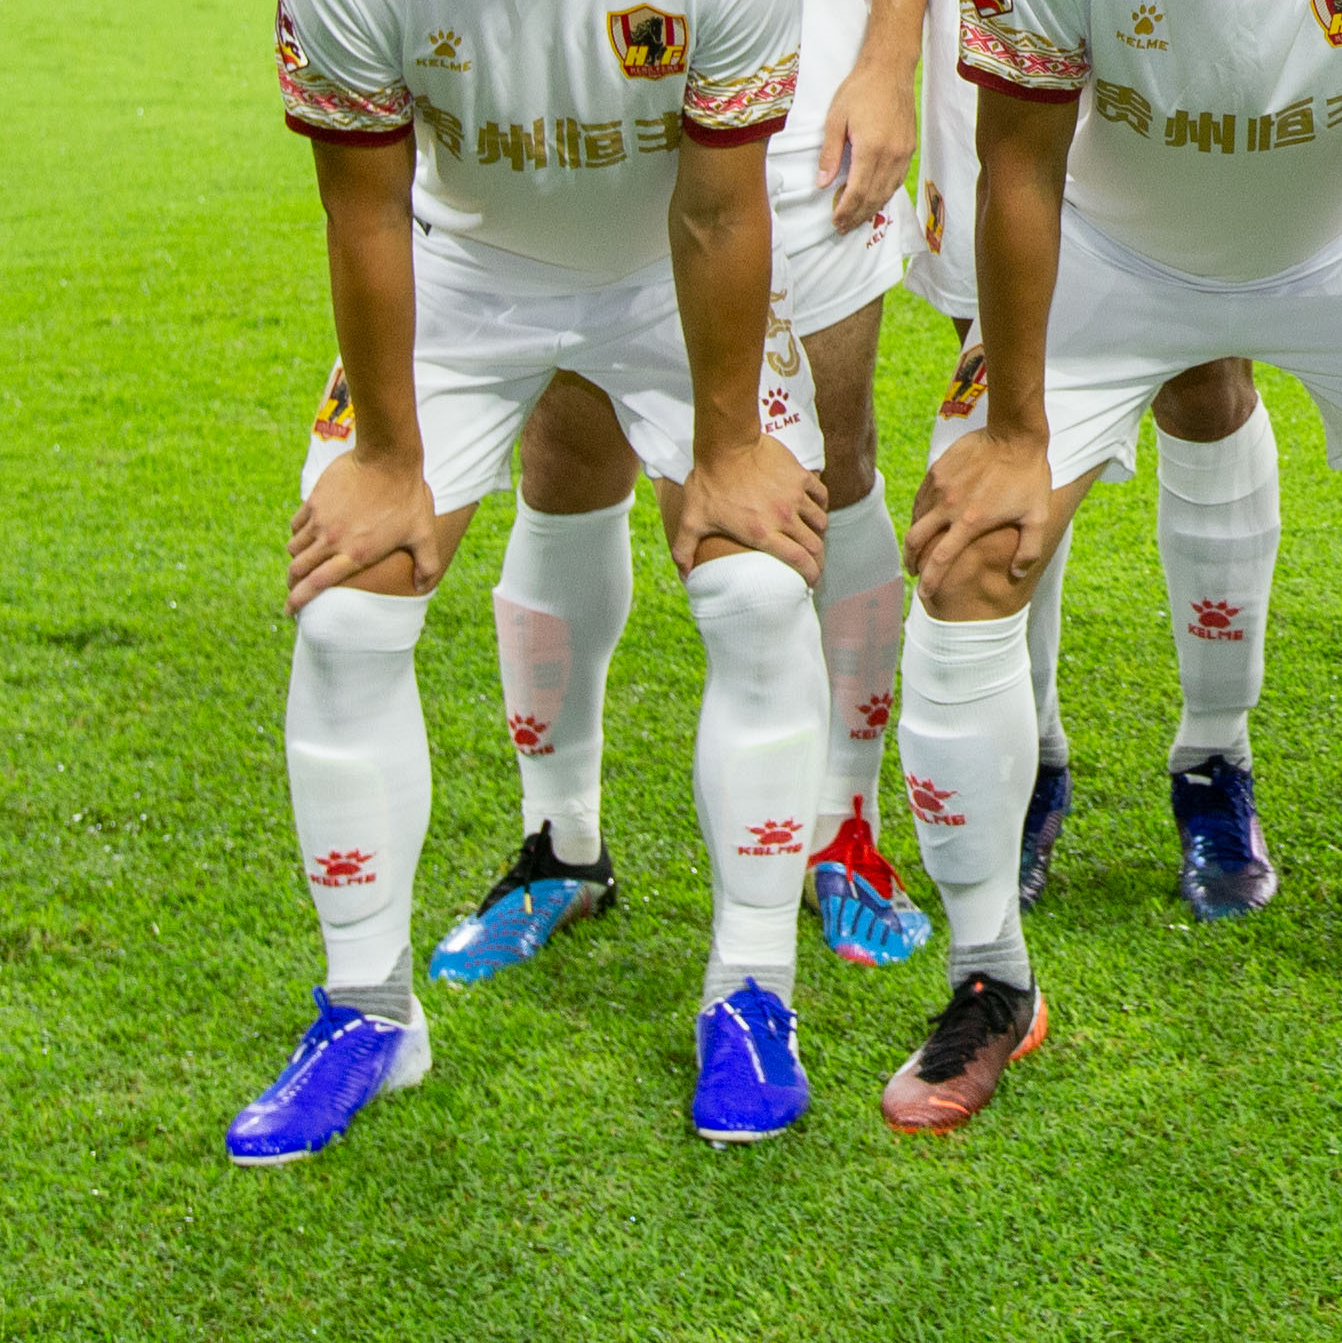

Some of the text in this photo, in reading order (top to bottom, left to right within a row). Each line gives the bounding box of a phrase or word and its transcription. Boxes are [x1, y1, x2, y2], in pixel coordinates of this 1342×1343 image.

[1116, 30, 1169, 52] KELME
[416, 58, 472, 73] KELME
[764, 412, 801, 434] ELME
[1188, 623, 1243, 640] KELME
[738, 843, 802, 855] KELME
[310, 873, 376, 887] KELME
